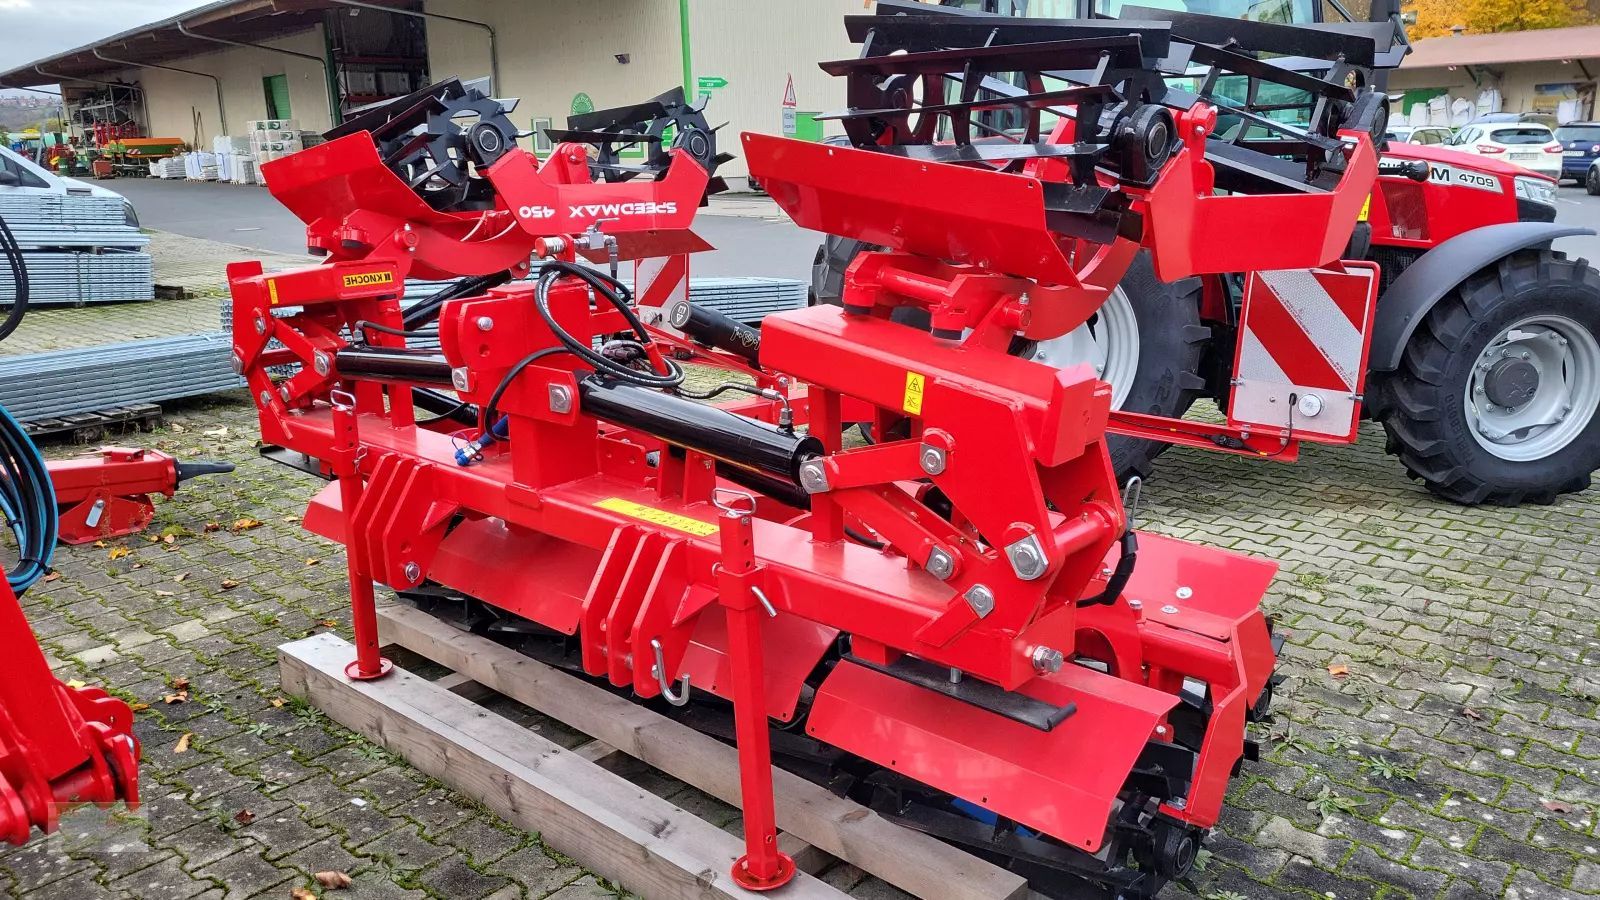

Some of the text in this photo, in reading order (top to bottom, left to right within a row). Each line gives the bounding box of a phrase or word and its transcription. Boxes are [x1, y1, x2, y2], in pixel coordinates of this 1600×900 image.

[1431, 167, 1494, 188] M 4709
[518, 201, 678, 219] SPEEDMAX 450
[345, 274, 383, 285] KNOCHE
